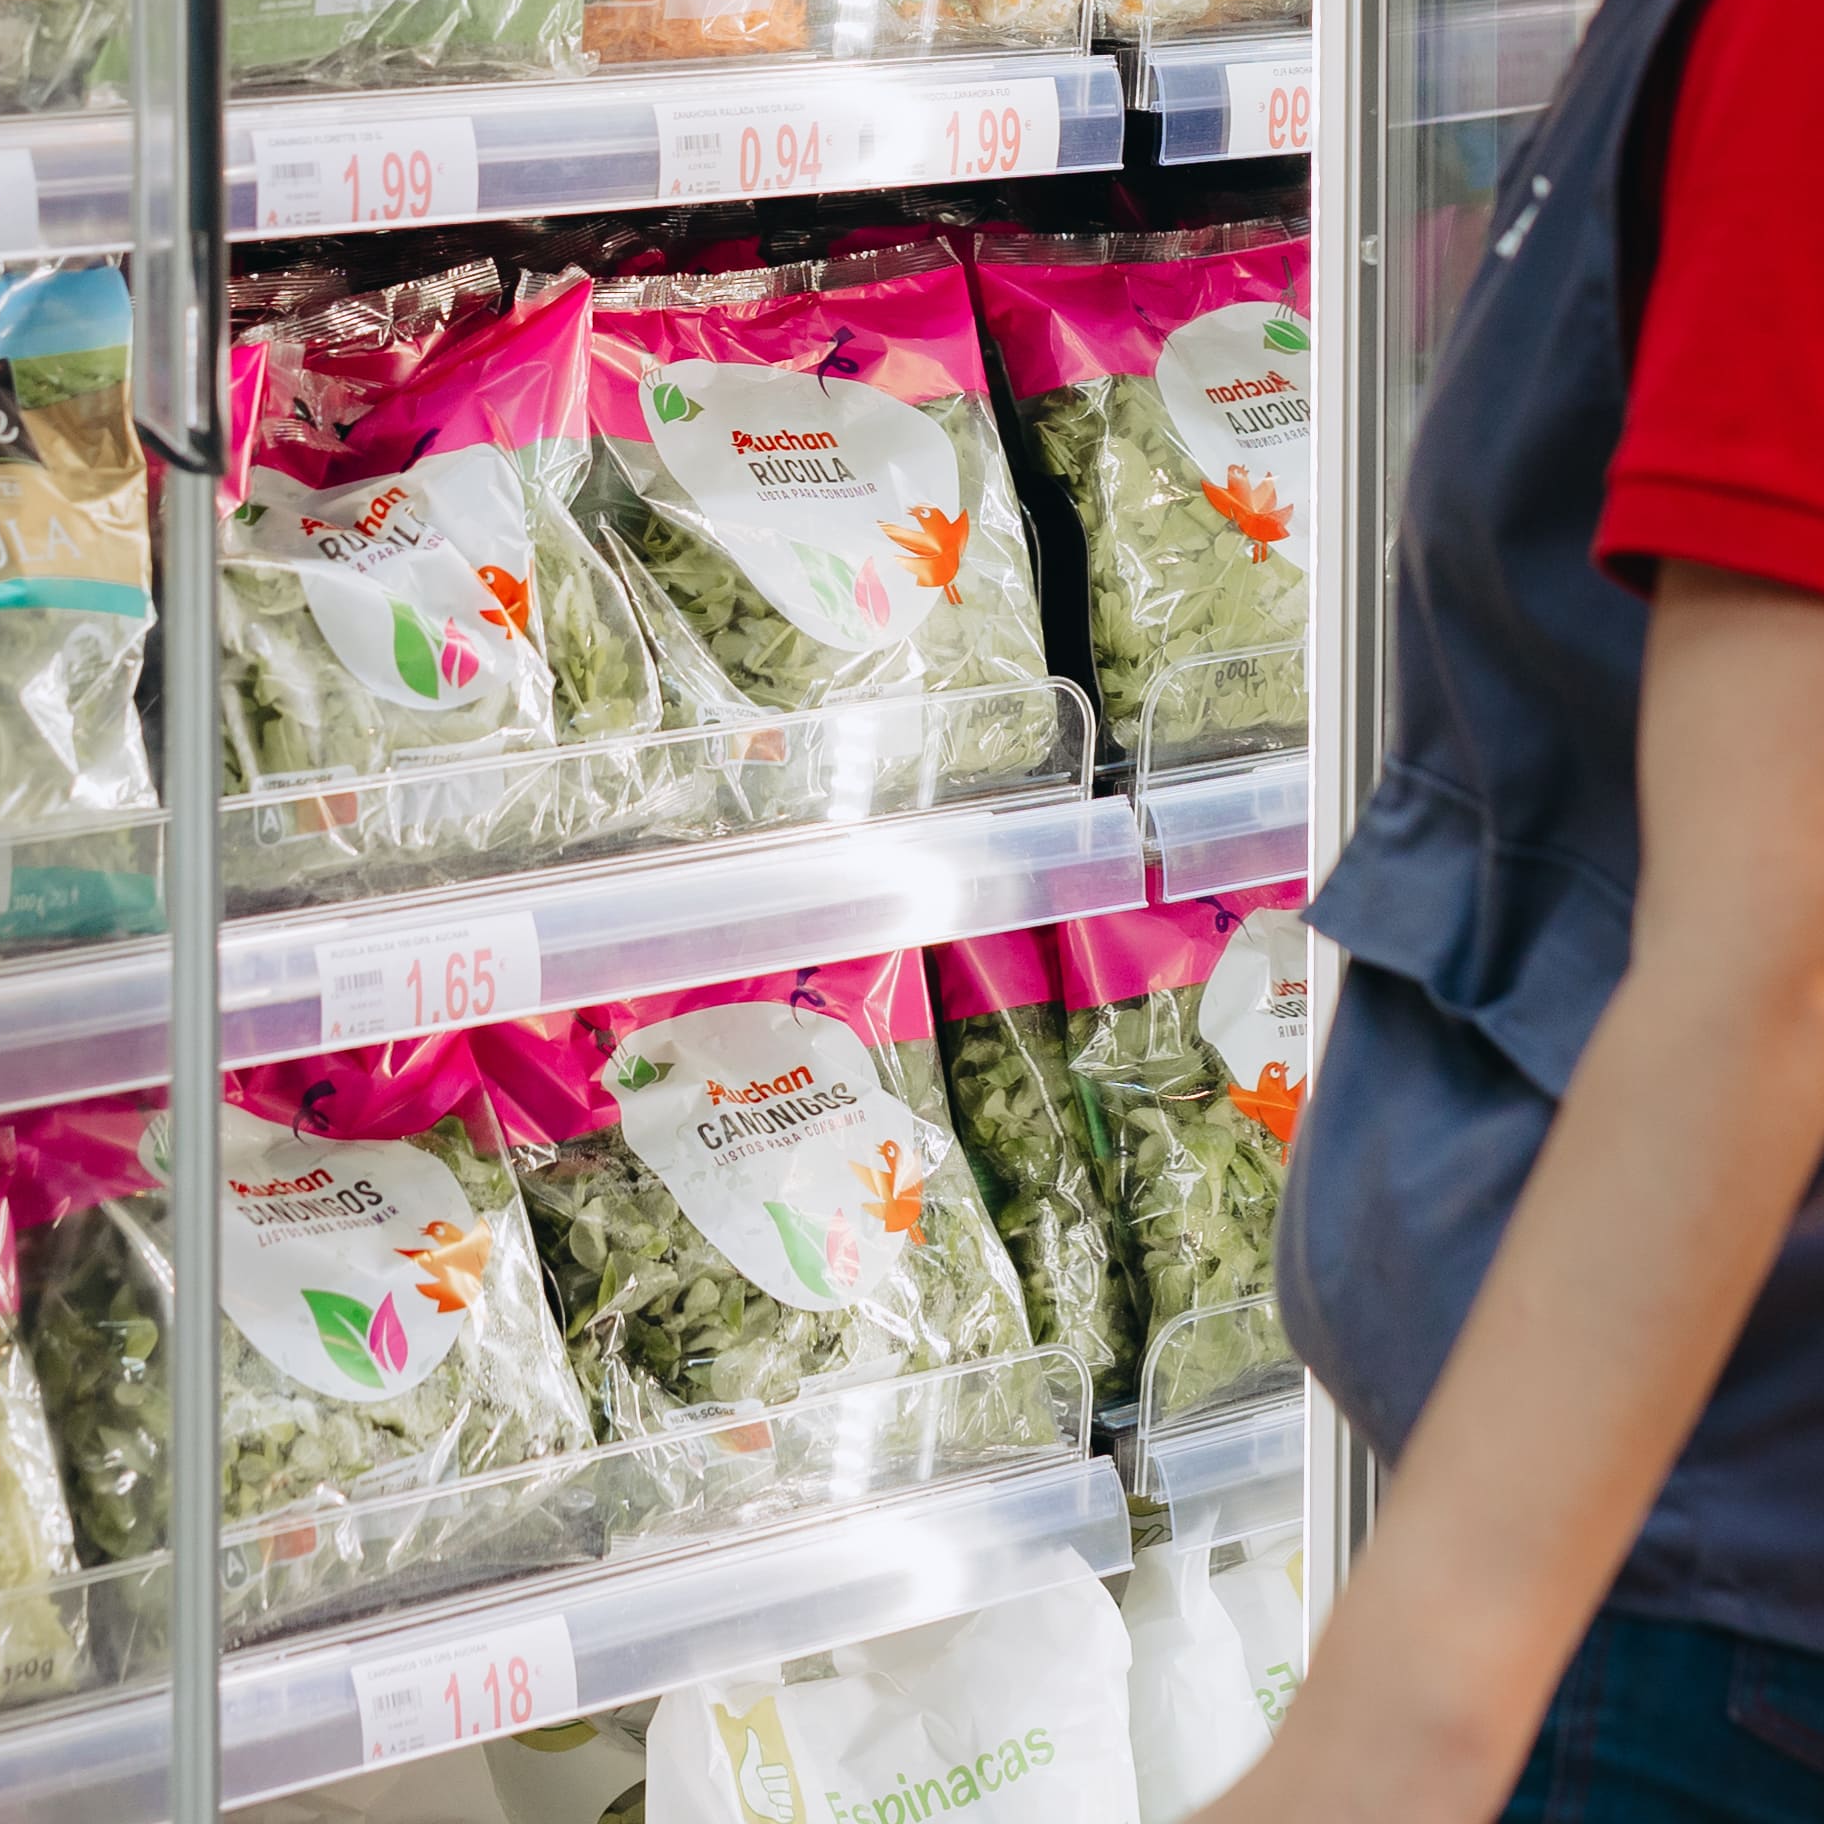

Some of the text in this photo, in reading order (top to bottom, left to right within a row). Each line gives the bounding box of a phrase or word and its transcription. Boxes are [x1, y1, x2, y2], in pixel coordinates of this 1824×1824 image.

[739, 120, 823, 193] 0.94
[945, 106, 1022, 176] 1.99
[343, 149, 433, 223] 1.99
[730, 428, 840, 455] Auchan
[747, 454, 858, 487] RÚCULA
[756, 481, 878, 502] LISTA PARA CONSUMIR
[406, 947, 496, 1027] 1.65
[705, 1064, 815, 1106] Auchan
[697, 1082, 859, 1151] CANÓNIGOS
[713, 1139, 765, 1168] LISTOS
[766, 1132, 803, 1150] PARA
[228, 1167, 335, 1199] Auchan
[237, 1179, 384, 1226] CANÓNIGOS
[443, 1655, 533, 1741] 1.18
[825, 1724, 1058, 1824] Espinacas
